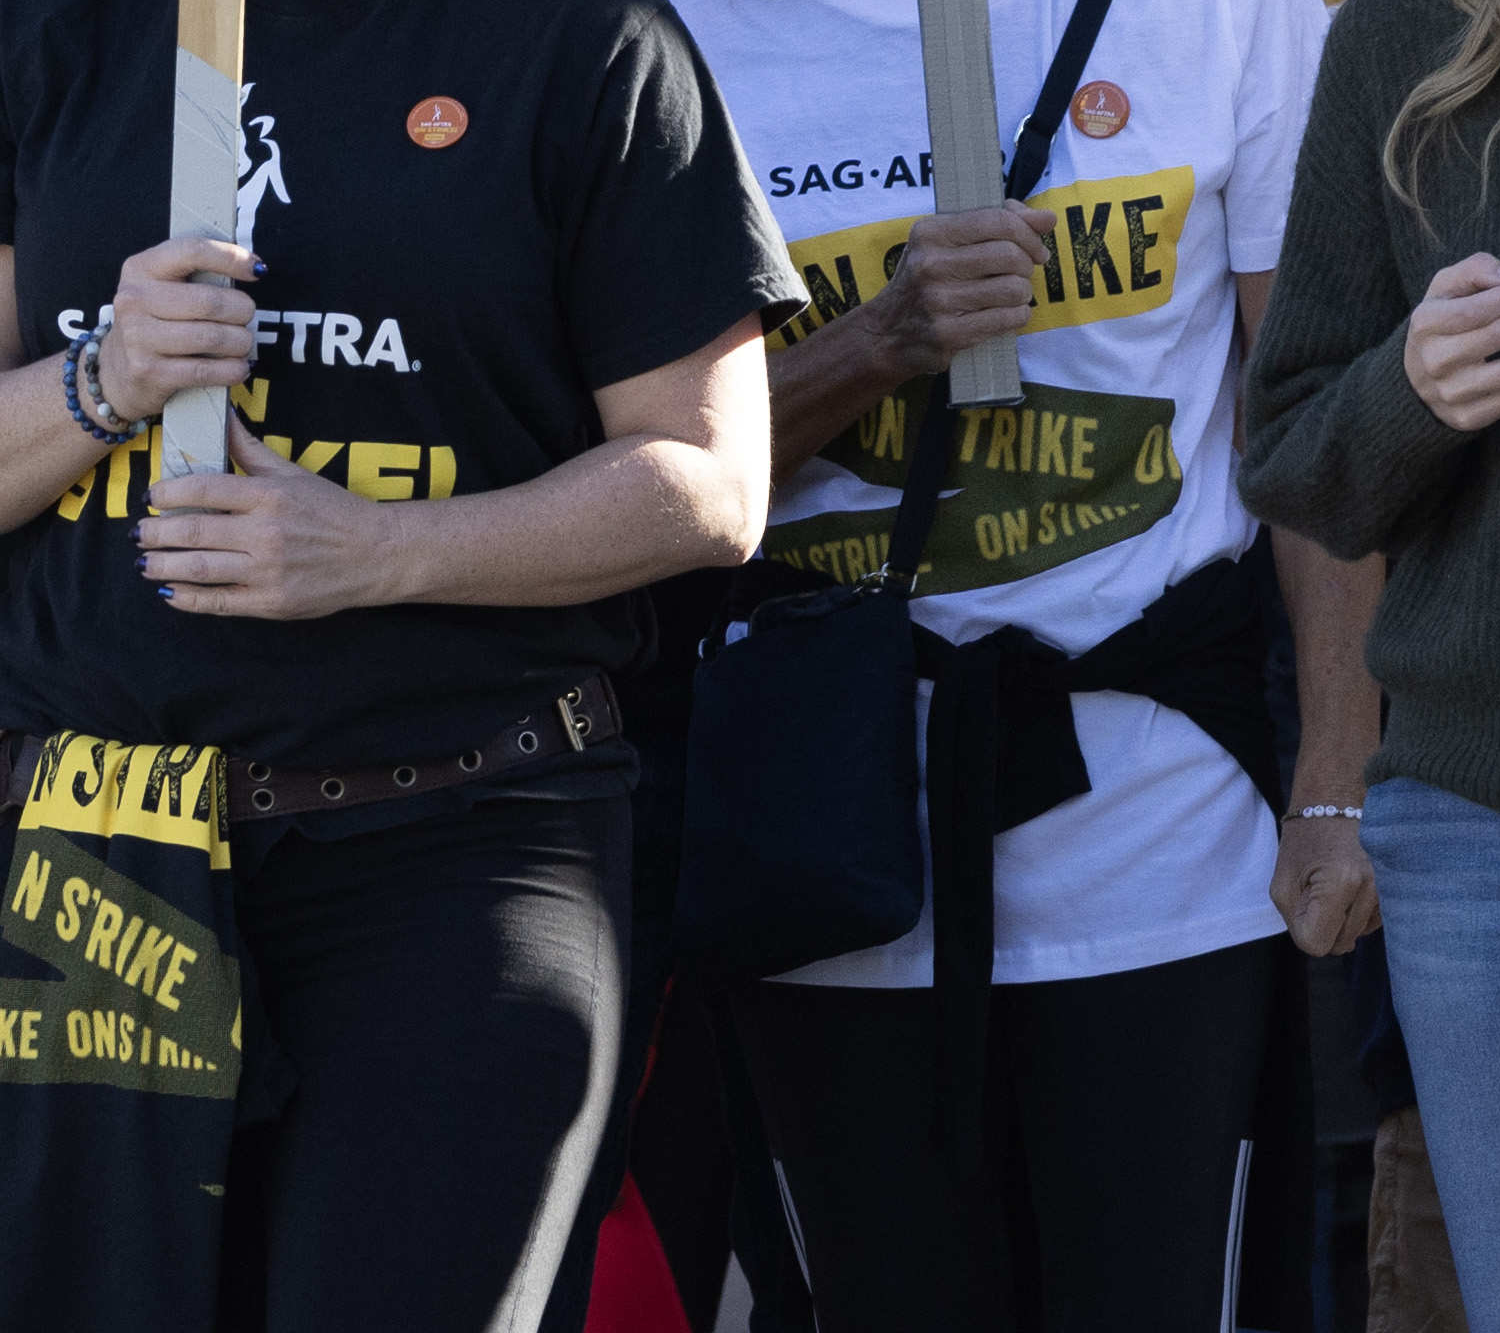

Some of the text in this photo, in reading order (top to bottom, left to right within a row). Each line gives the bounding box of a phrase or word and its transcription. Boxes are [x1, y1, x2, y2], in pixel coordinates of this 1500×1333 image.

[230, 377, 269, 423] N
[959, 408, 1099, 482] TRIKE
[10, 850, 53, 921] N
